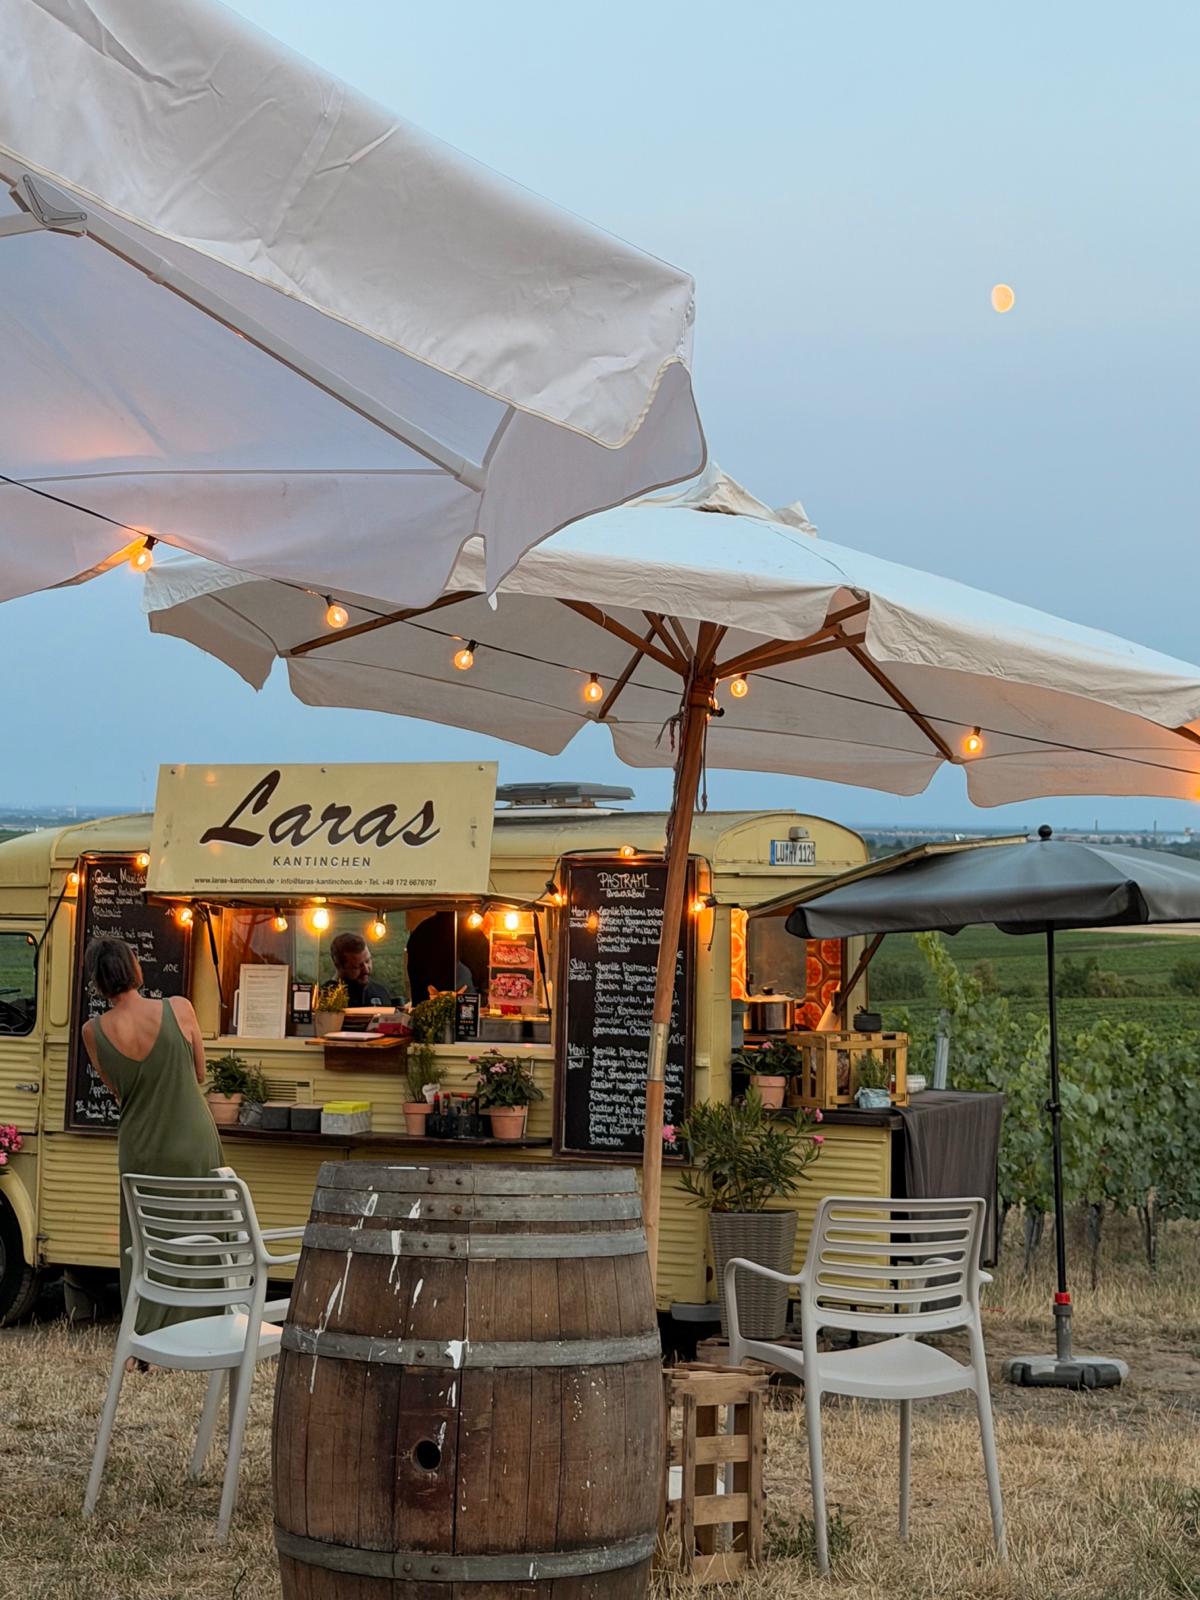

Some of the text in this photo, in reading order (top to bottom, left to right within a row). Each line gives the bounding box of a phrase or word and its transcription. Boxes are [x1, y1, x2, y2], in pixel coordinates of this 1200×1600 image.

[199, 769, 441, 848] Laras
[272, 855, 372, 868] KANTINCHEN
[193, 876, 275, 885] www.laras-kantinchen.de
[280, 877, 363, 887] info@laras-kantinchen.de
[368, 878, 380, 887] Tel.
[396, 879, 408, 887] 172
[597, 872, 650, 888] PASTRAMI
